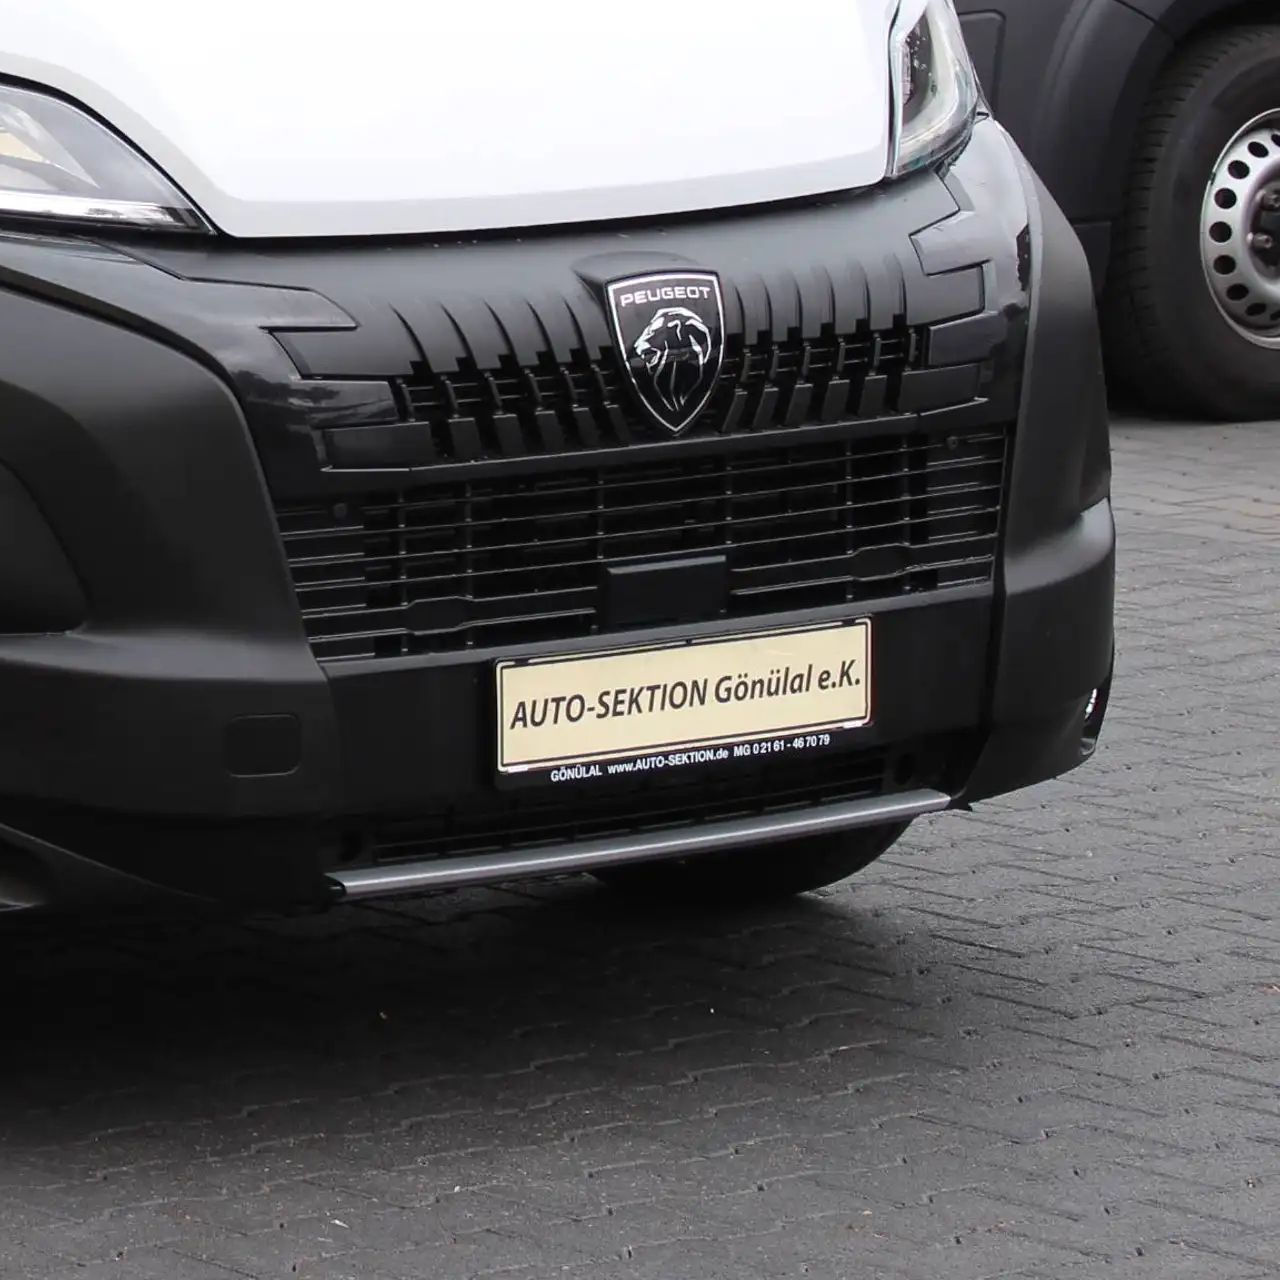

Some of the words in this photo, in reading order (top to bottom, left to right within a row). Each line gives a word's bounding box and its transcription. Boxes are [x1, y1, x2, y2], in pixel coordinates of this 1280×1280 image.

[620, 286, 712, 308] PEUGEOT
[509, 677, 709, 730] AUTO-SEKTION
[714, 663, 814, 704] Gönülal
[817, 659, 861, 691] e.K.
[550, 764, 603, 783] GÖNÜLAL
[607, 749, 730, 775] www.AUTO-SEKTION.de
[733, 744, 751, 757] MG
